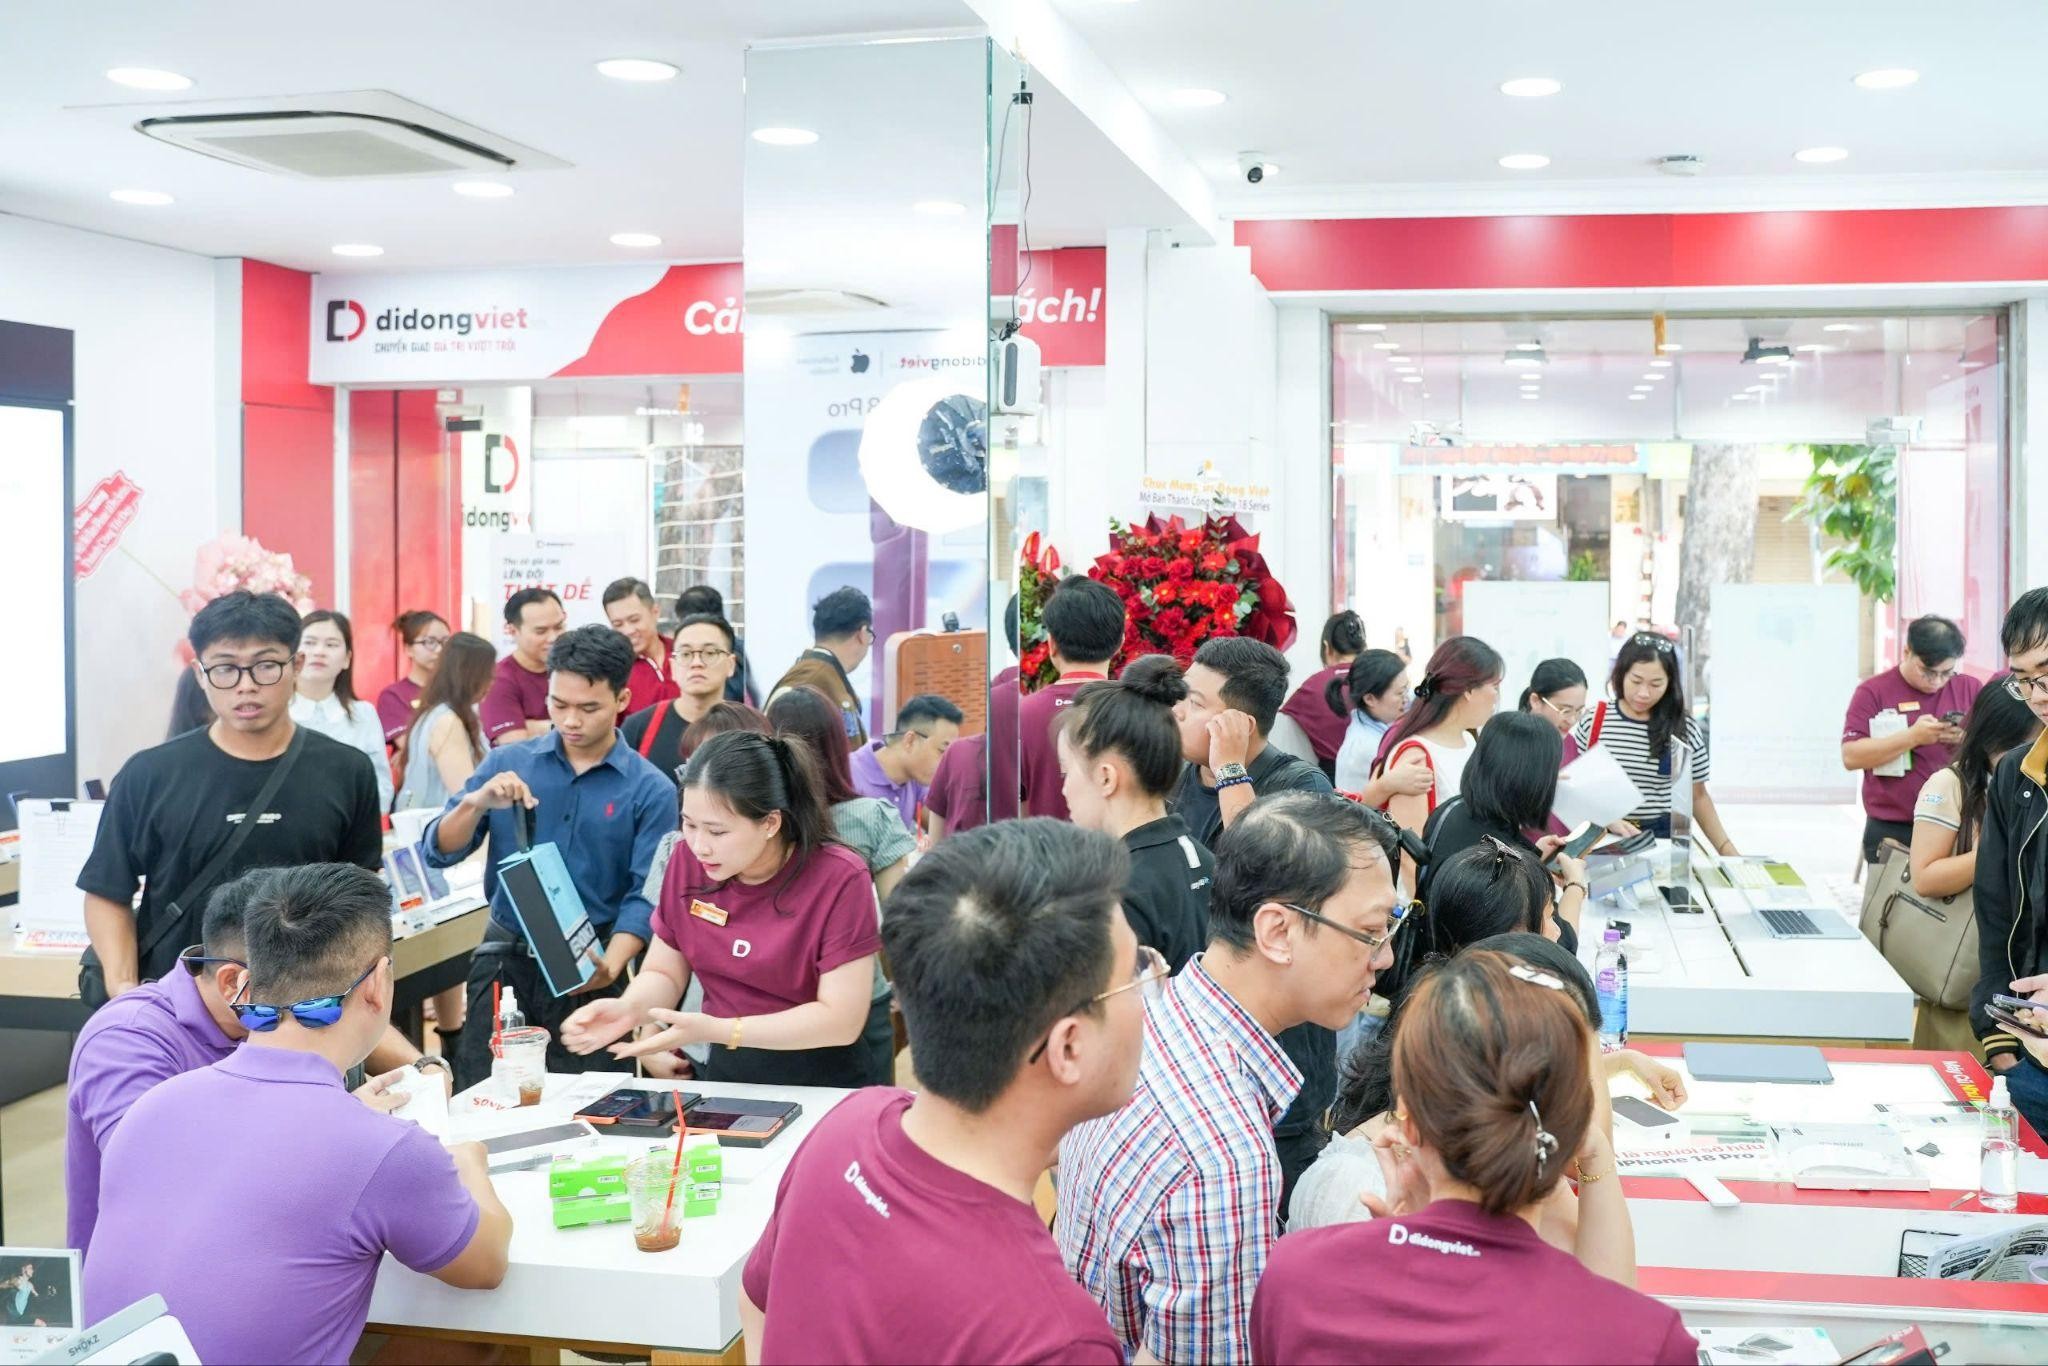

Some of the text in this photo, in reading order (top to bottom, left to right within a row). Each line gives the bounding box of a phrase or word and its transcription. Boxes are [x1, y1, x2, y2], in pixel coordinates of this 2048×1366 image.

[376, 308, 528, 335] didongviet
[684, 297, 744, 336] Cả
[68, 1333, 101, 1357] SHOKZ
